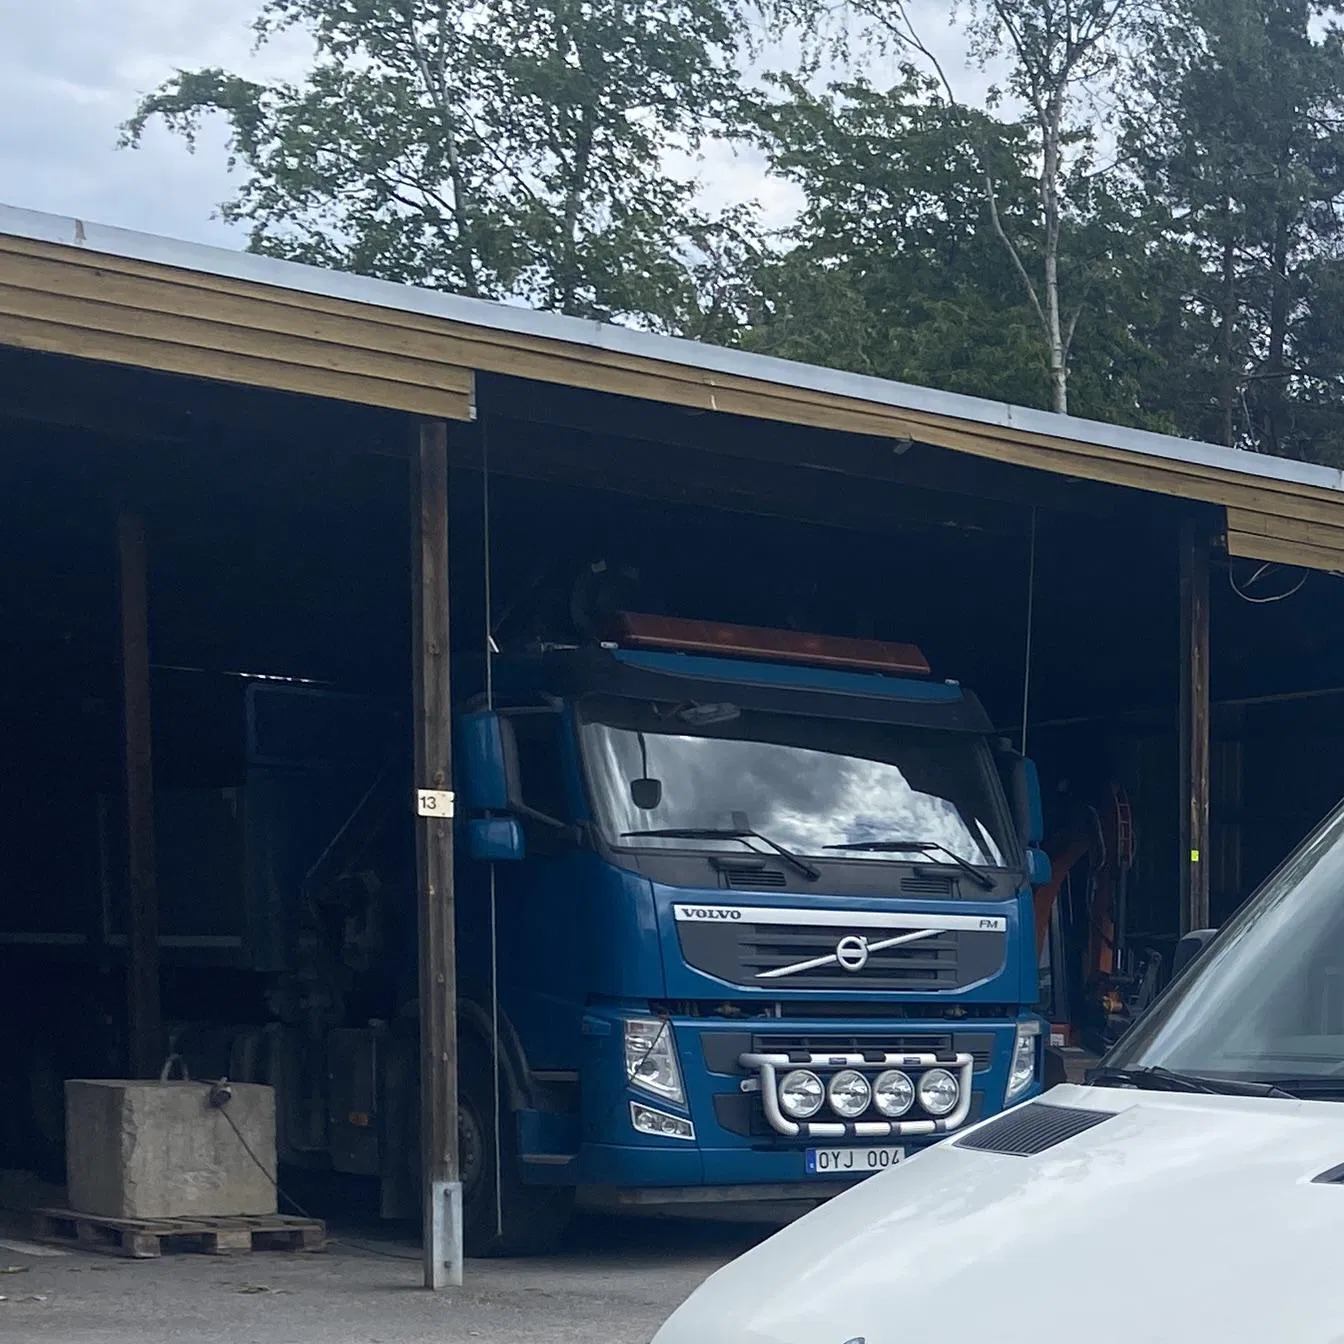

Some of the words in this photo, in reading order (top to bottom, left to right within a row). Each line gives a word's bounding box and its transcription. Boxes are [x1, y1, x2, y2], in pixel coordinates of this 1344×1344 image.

[420, 796, 437, 810] 13
[681, 908, 742, 920] VOLVO
[979, 919, 999, 929] FM
[819, 1151, 854, 1169] OYJ
